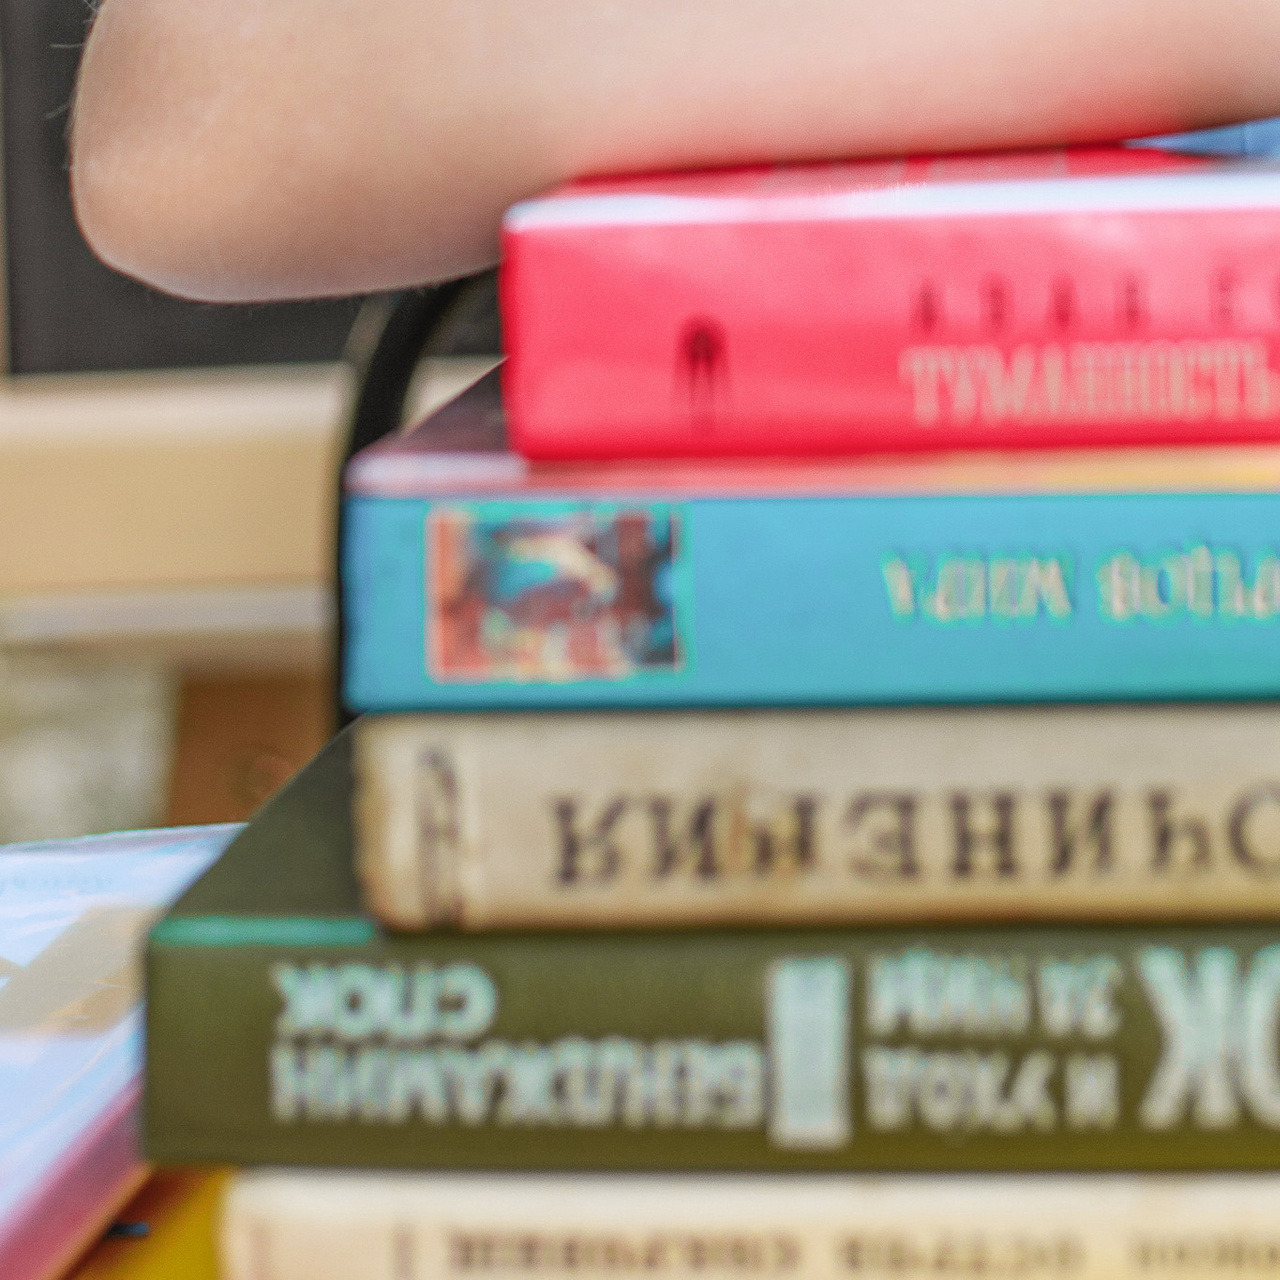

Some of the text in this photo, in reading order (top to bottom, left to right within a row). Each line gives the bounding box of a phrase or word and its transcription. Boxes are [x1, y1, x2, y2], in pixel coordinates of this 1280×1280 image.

[275, 962, 498, 1042] СПОК
[270, 1040, 766, 1128] БЕНДЖАМИН
[864, 1045, 1056, 1130] УХОД
